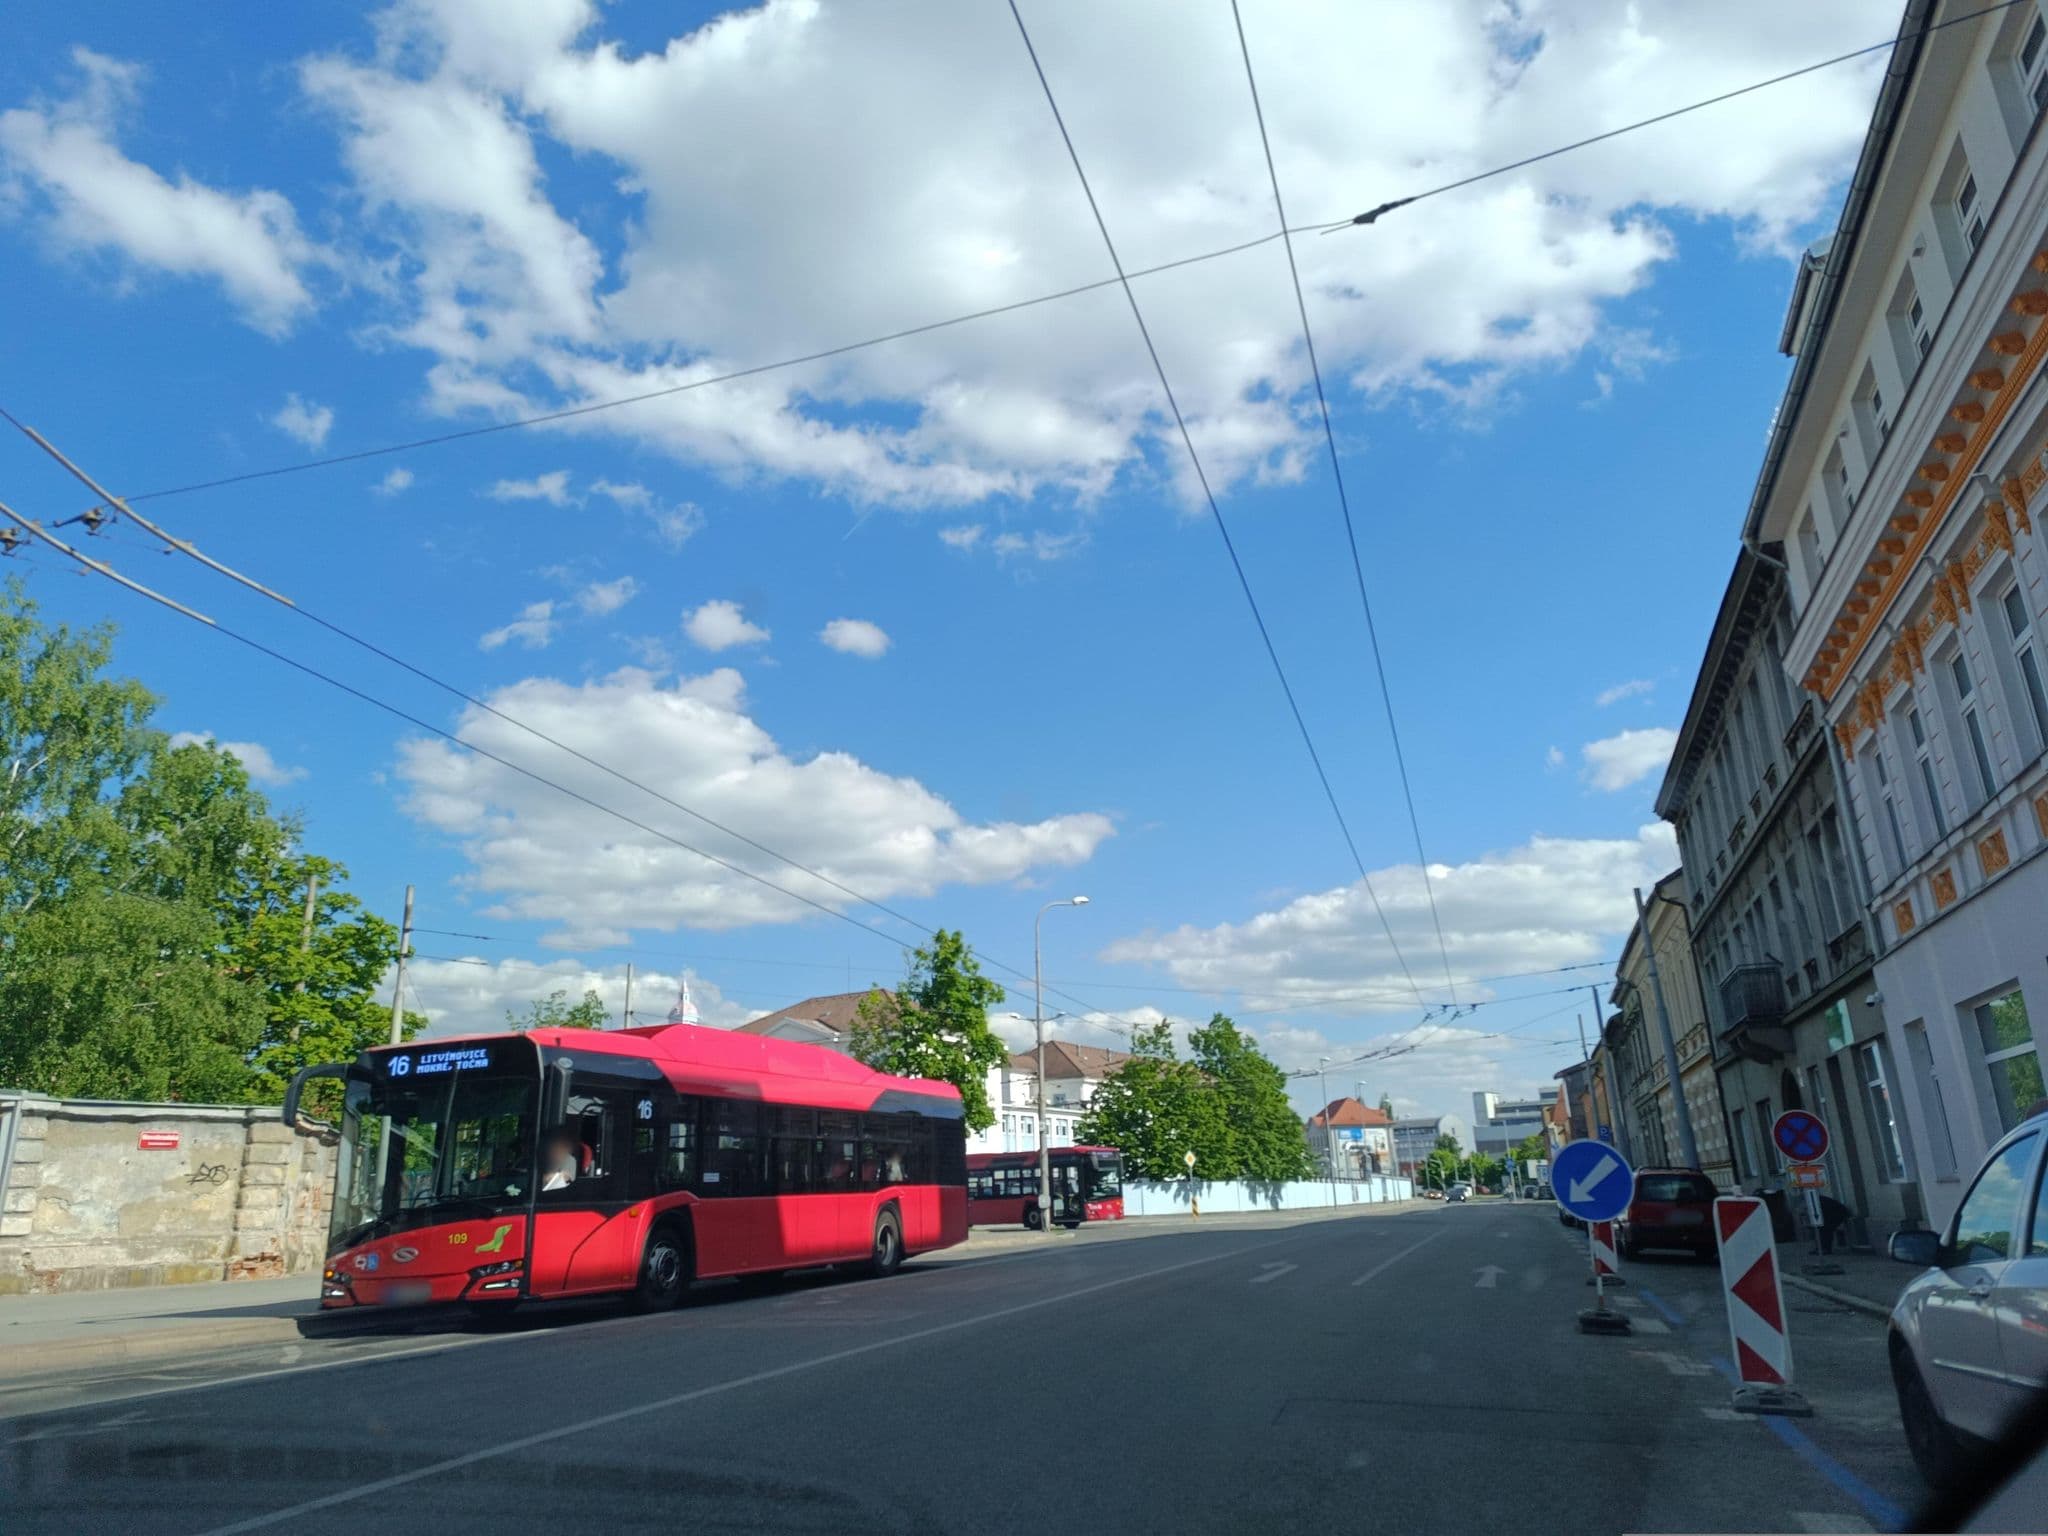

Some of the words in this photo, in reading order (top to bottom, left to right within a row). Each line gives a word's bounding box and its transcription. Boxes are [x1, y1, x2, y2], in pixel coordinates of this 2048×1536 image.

[388, 1055, 411, 1077] 16
[637, 1099, 653, 1120] 16
[448, 1232, 468, 1245] 109
